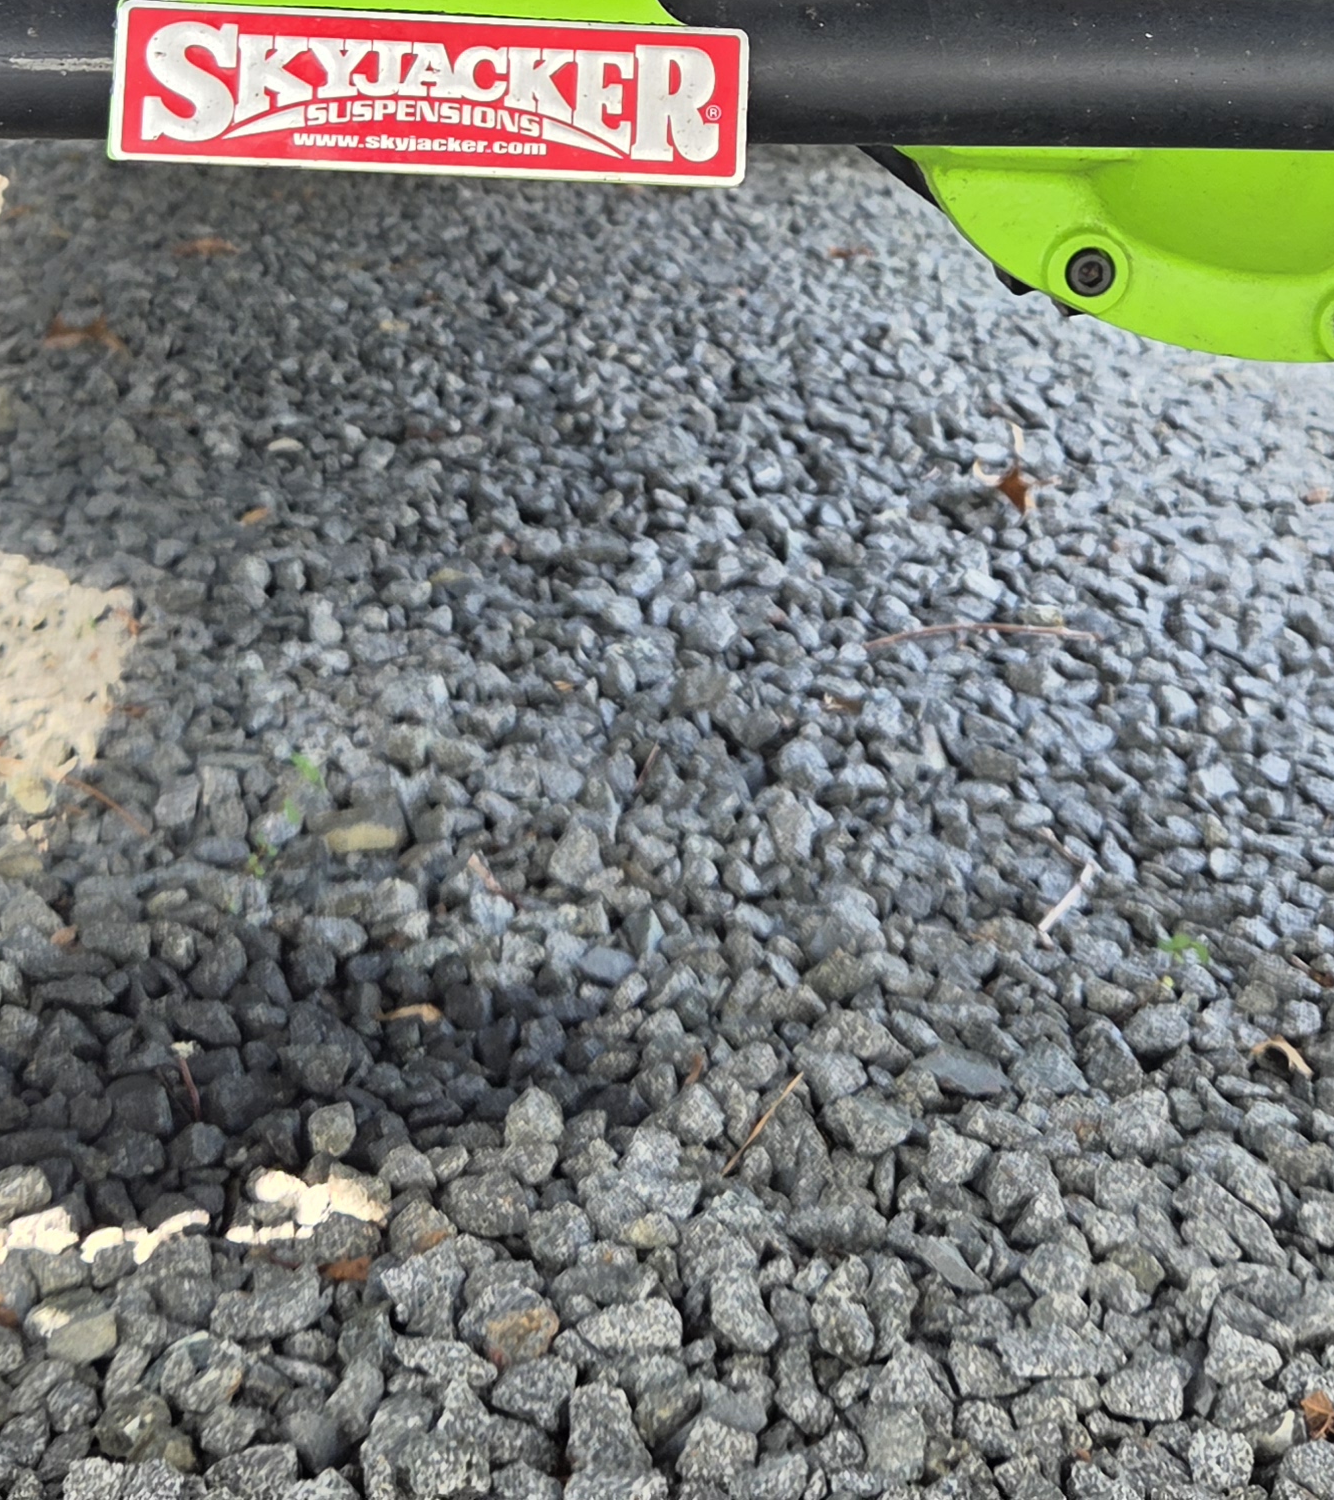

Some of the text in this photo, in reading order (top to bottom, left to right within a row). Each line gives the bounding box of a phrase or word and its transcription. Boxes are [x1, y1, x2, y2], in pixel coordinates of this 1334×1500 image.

[141, 21, 721, 163] SKYJACKER
[305, 99, 542, 138] SUSPENSIONS
[293, 130, 548, 157] www.skyjacker.com
